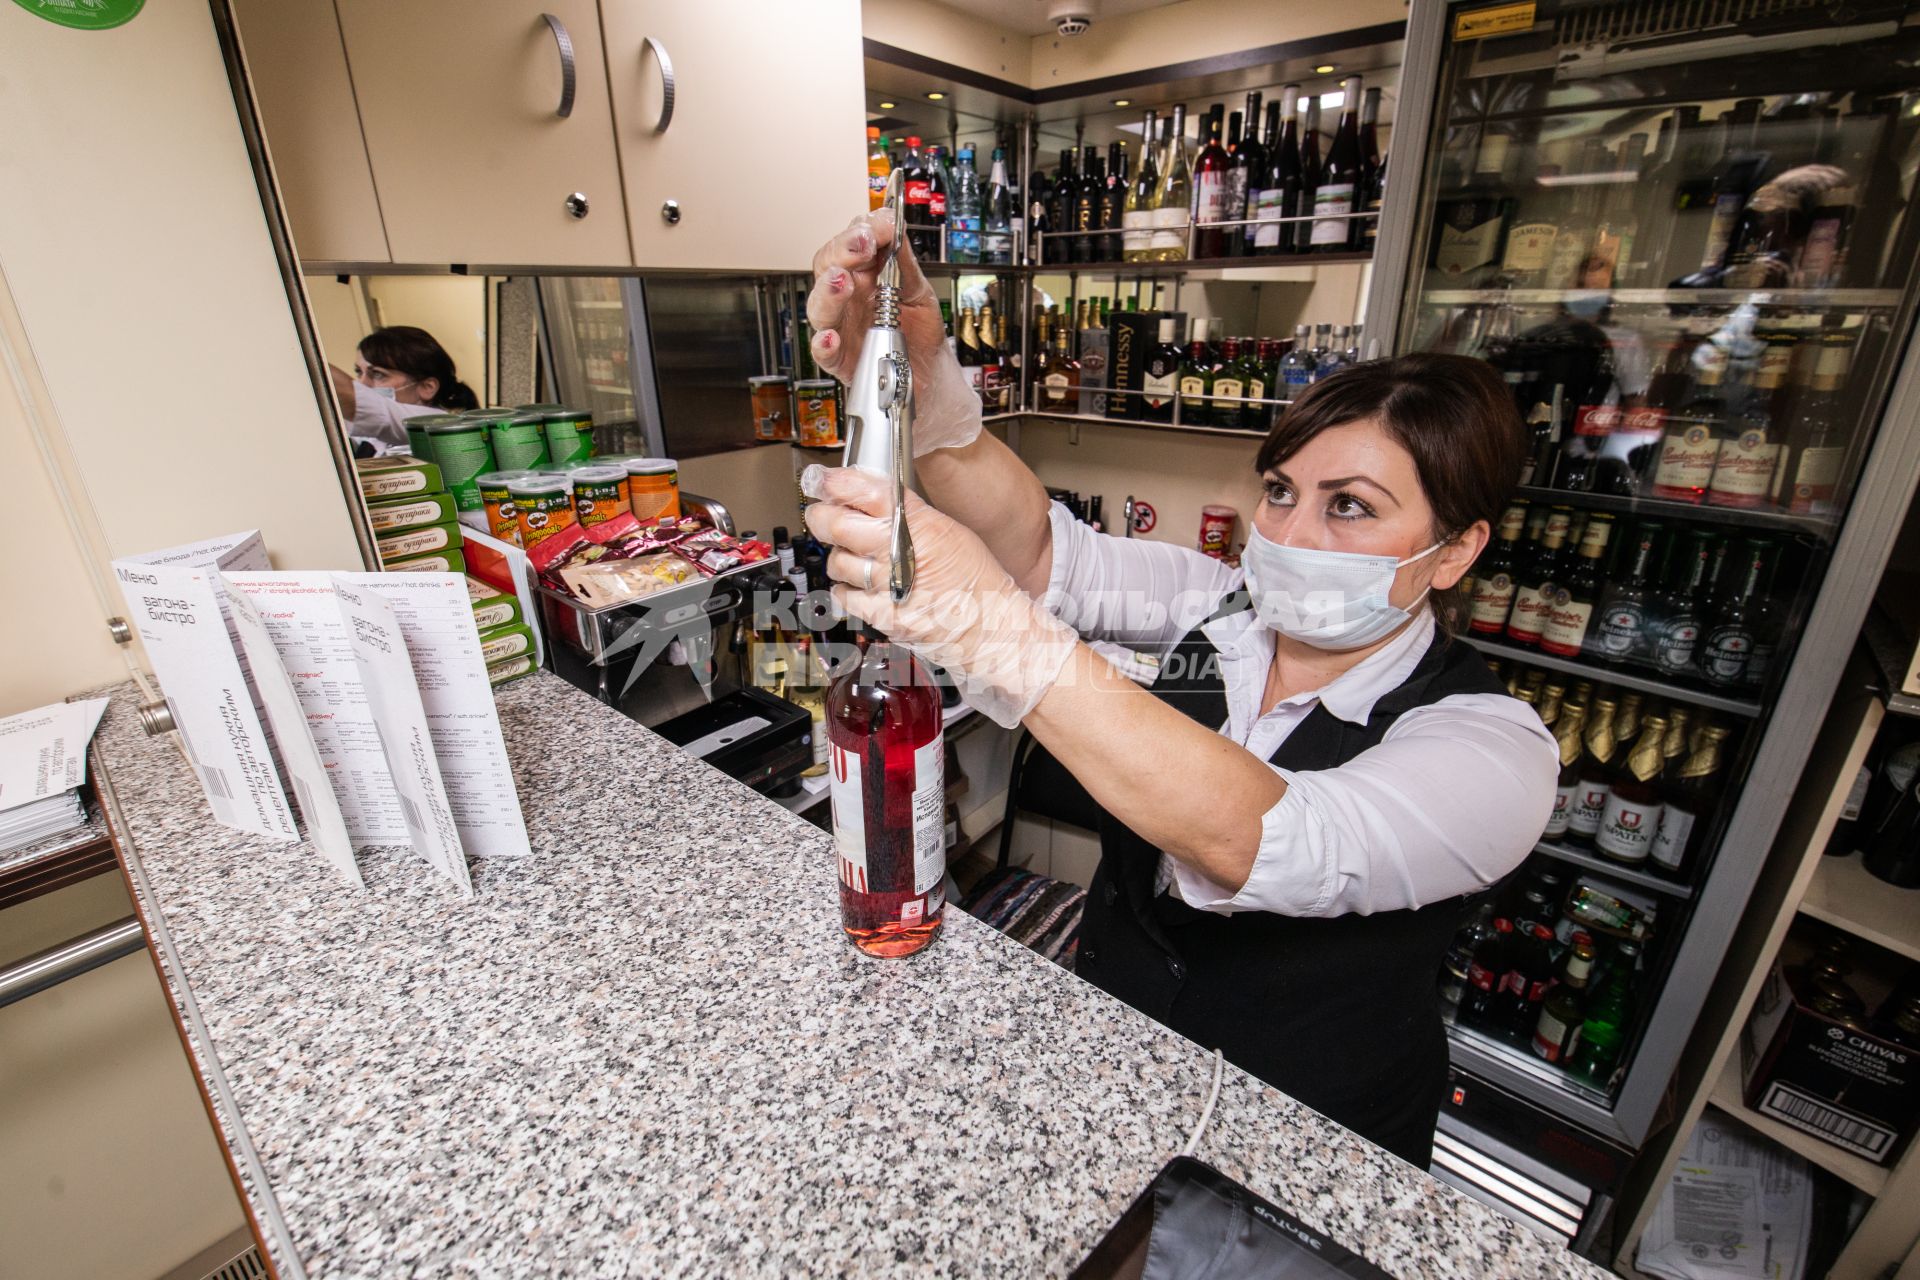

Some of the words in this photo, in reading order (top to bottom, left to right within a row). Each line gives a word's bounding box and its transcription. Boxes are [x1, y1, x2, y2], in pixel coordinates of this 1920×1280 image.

[1110, 322, 1134, 414] Hennessy
[117, 568, 158, 586] Меню
[148, 608, 196, 625] бистро
[356, 627, 392, 654] бистро
[218, 705, 244, 754] кухня
[222, 688, 259, 774] авторским
[236, 752, 275, 832] домашняя
[255, 776, 268, 794] по
[259, 762, 295, 835] рецептам
[1604, 823, 1649, 843] SPATEN
[1848, 1036, 1907, 1064] CHIVAS
